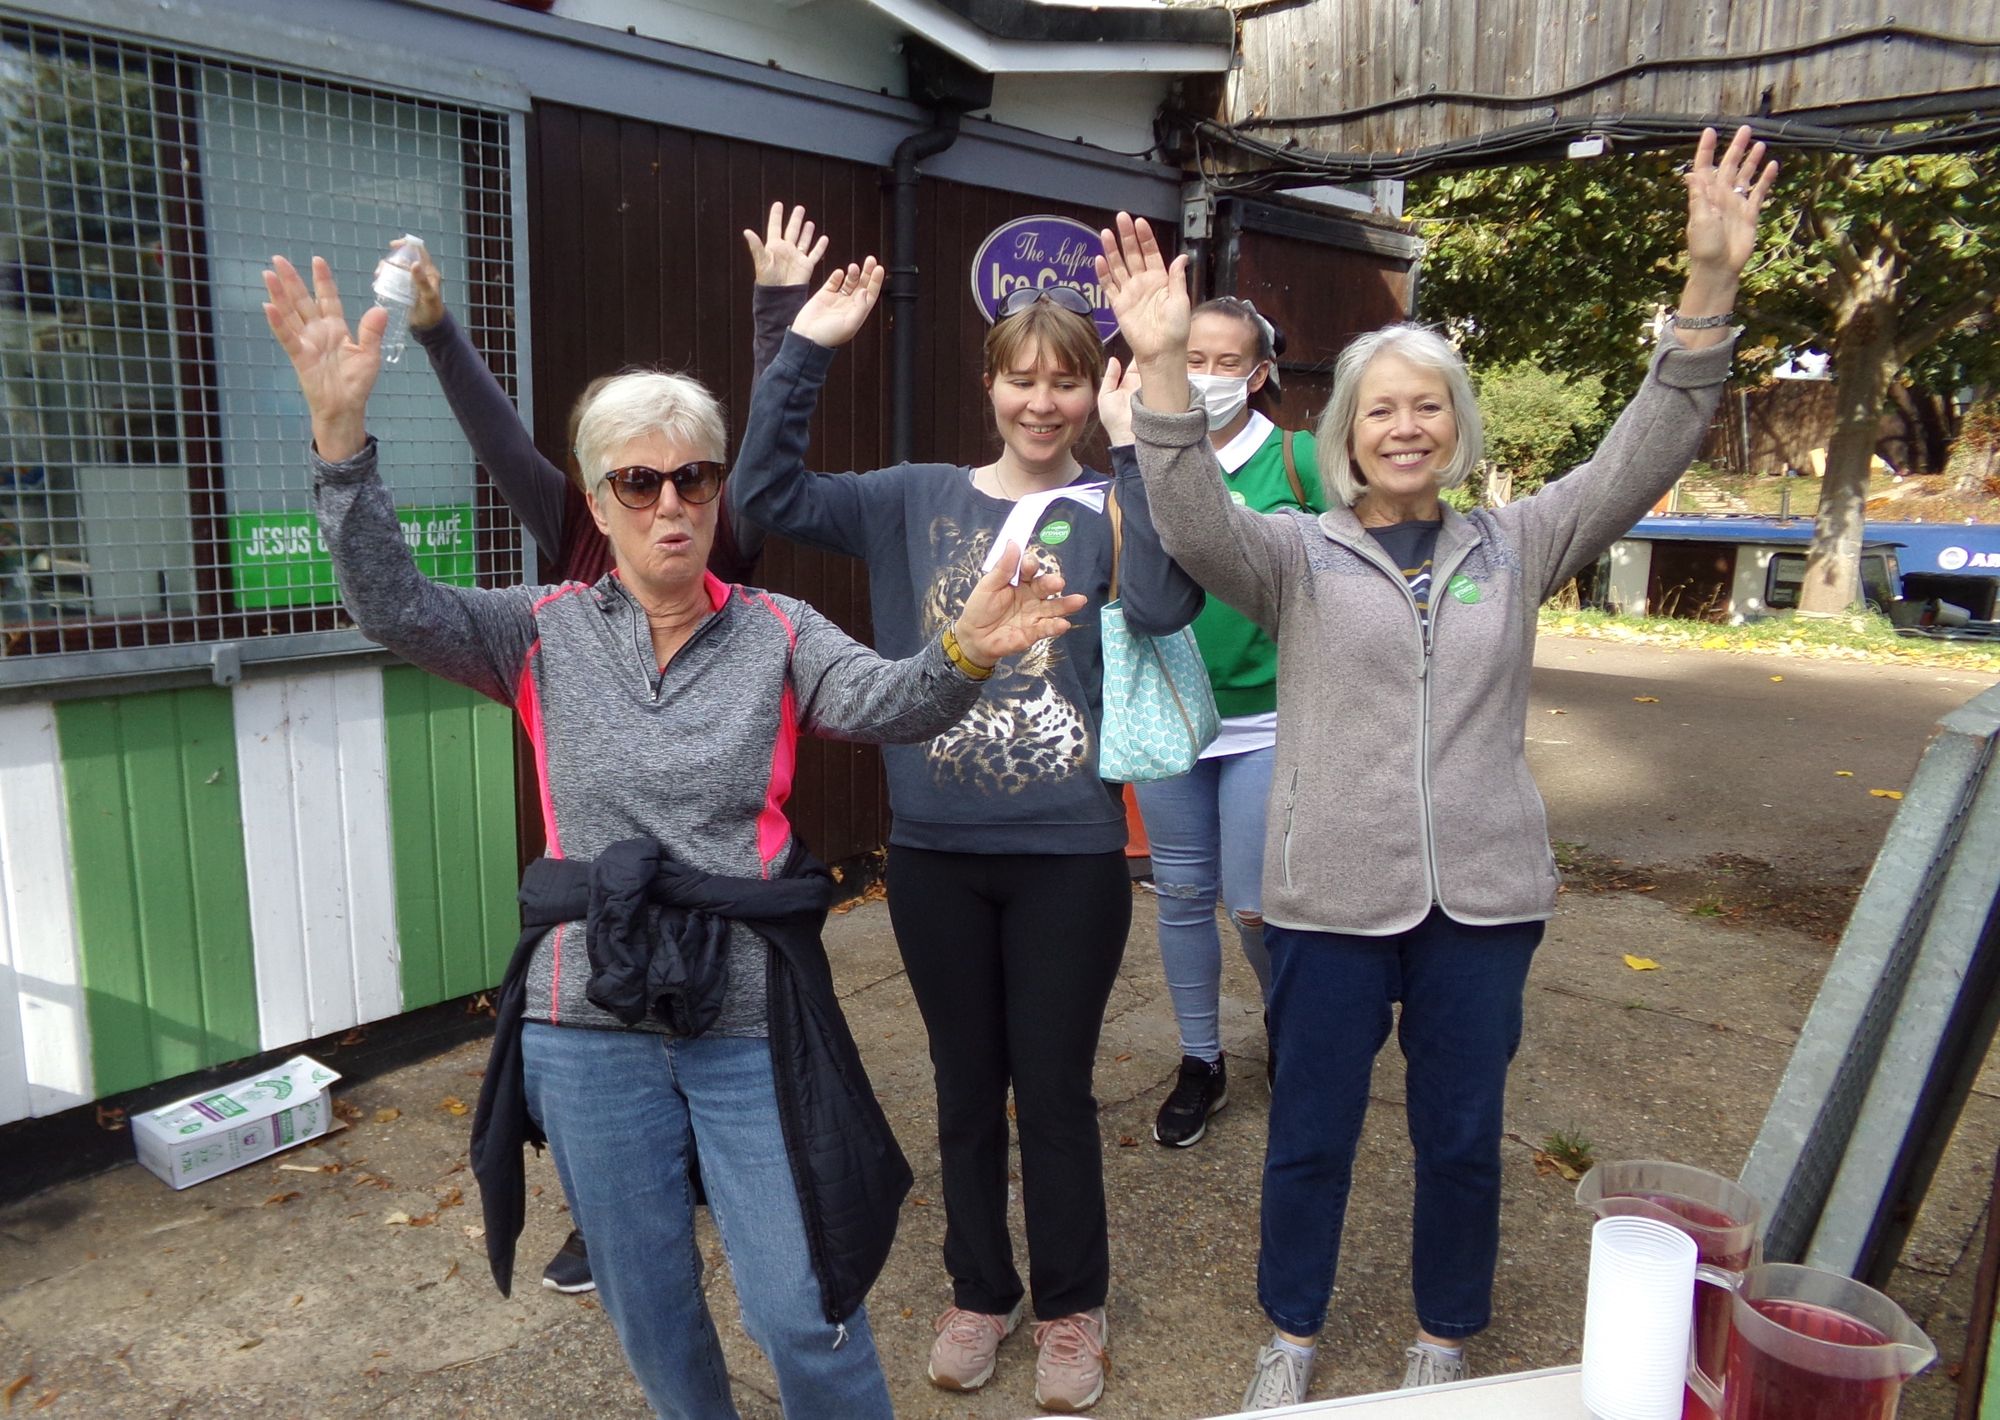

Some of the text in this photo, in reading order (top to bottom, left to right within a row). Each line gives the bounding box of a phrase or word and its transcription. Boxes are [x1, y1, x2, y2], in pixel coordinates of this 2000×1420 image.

[1014, 231, 1096, 277] The Saffro
[246, 526, 310, 556] JESUS
[426, 513, 462, 547] CAFÉ
